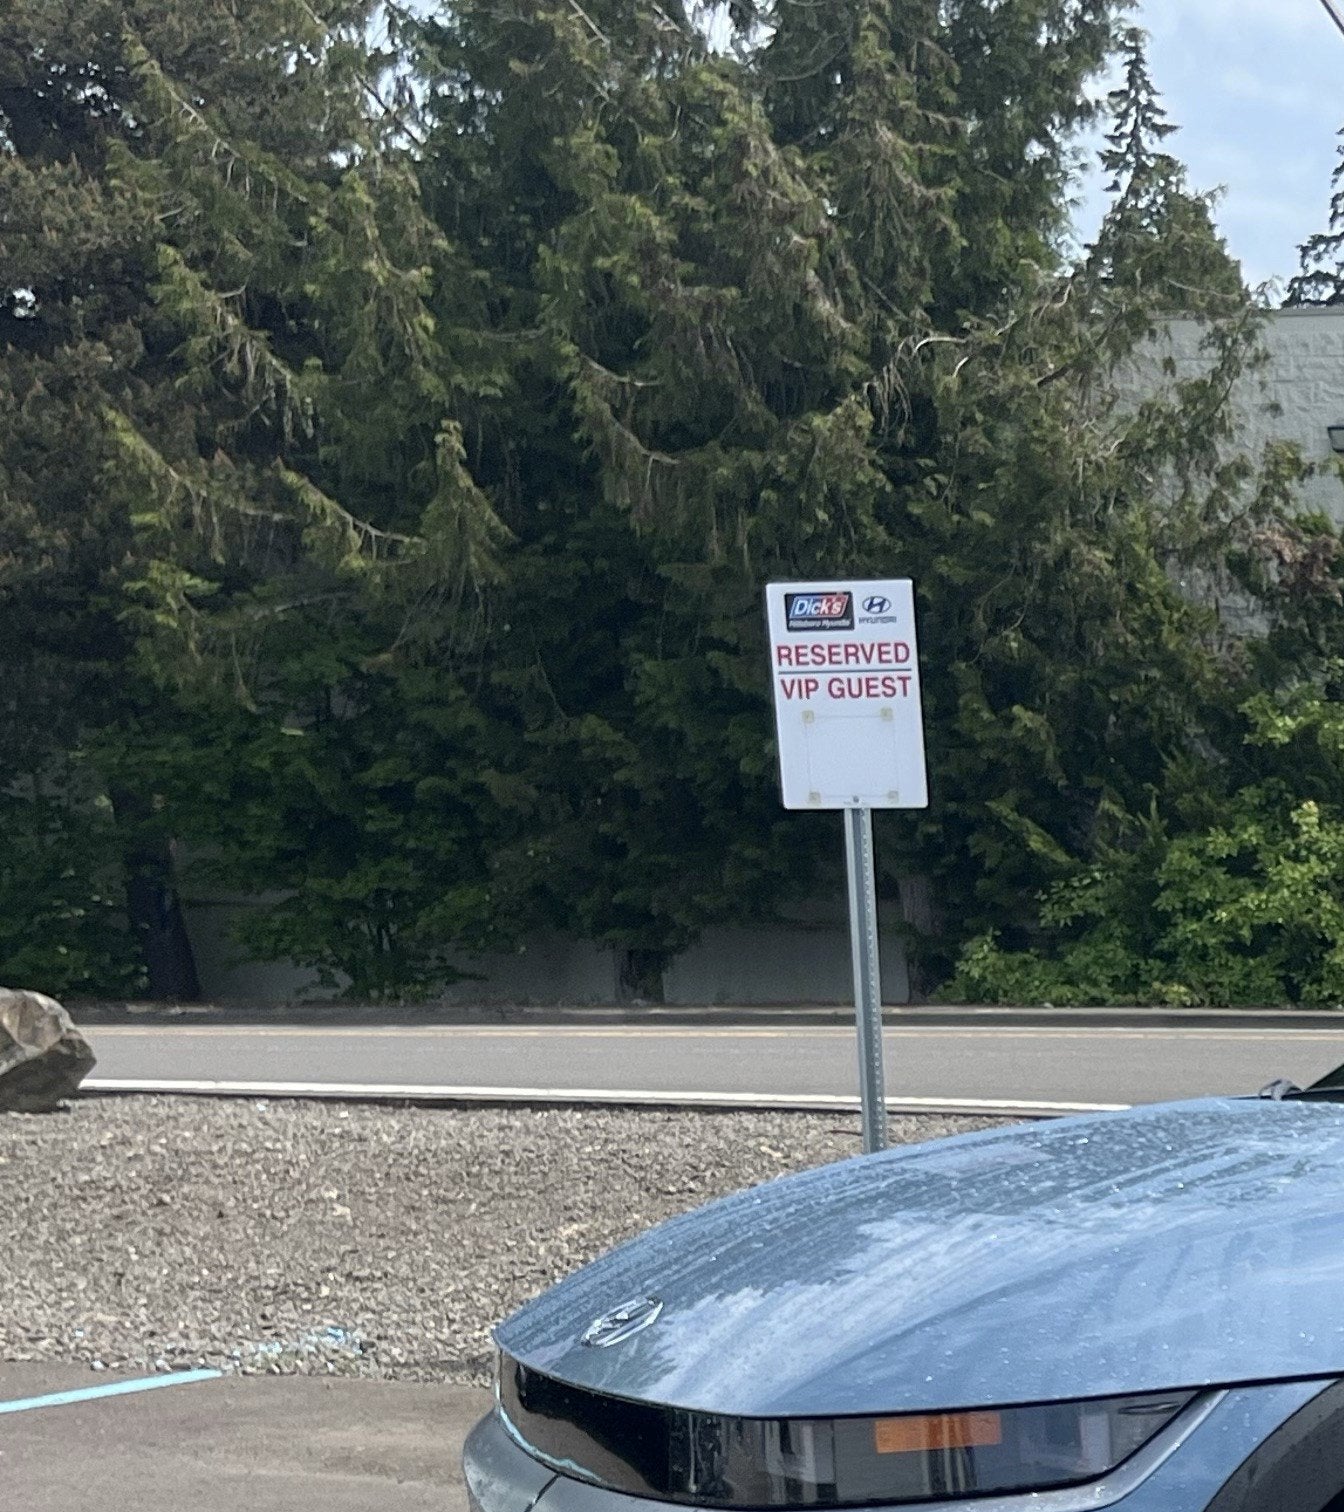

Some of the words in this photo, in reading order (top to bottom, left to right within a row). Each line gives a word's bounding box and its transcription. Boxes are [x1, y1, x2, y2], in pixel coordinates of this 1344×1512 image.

[776, 641, 911, 667] RESERVED
[780, 678, 819, 700] VIP
[827, 675, 912, 699] GUEST
